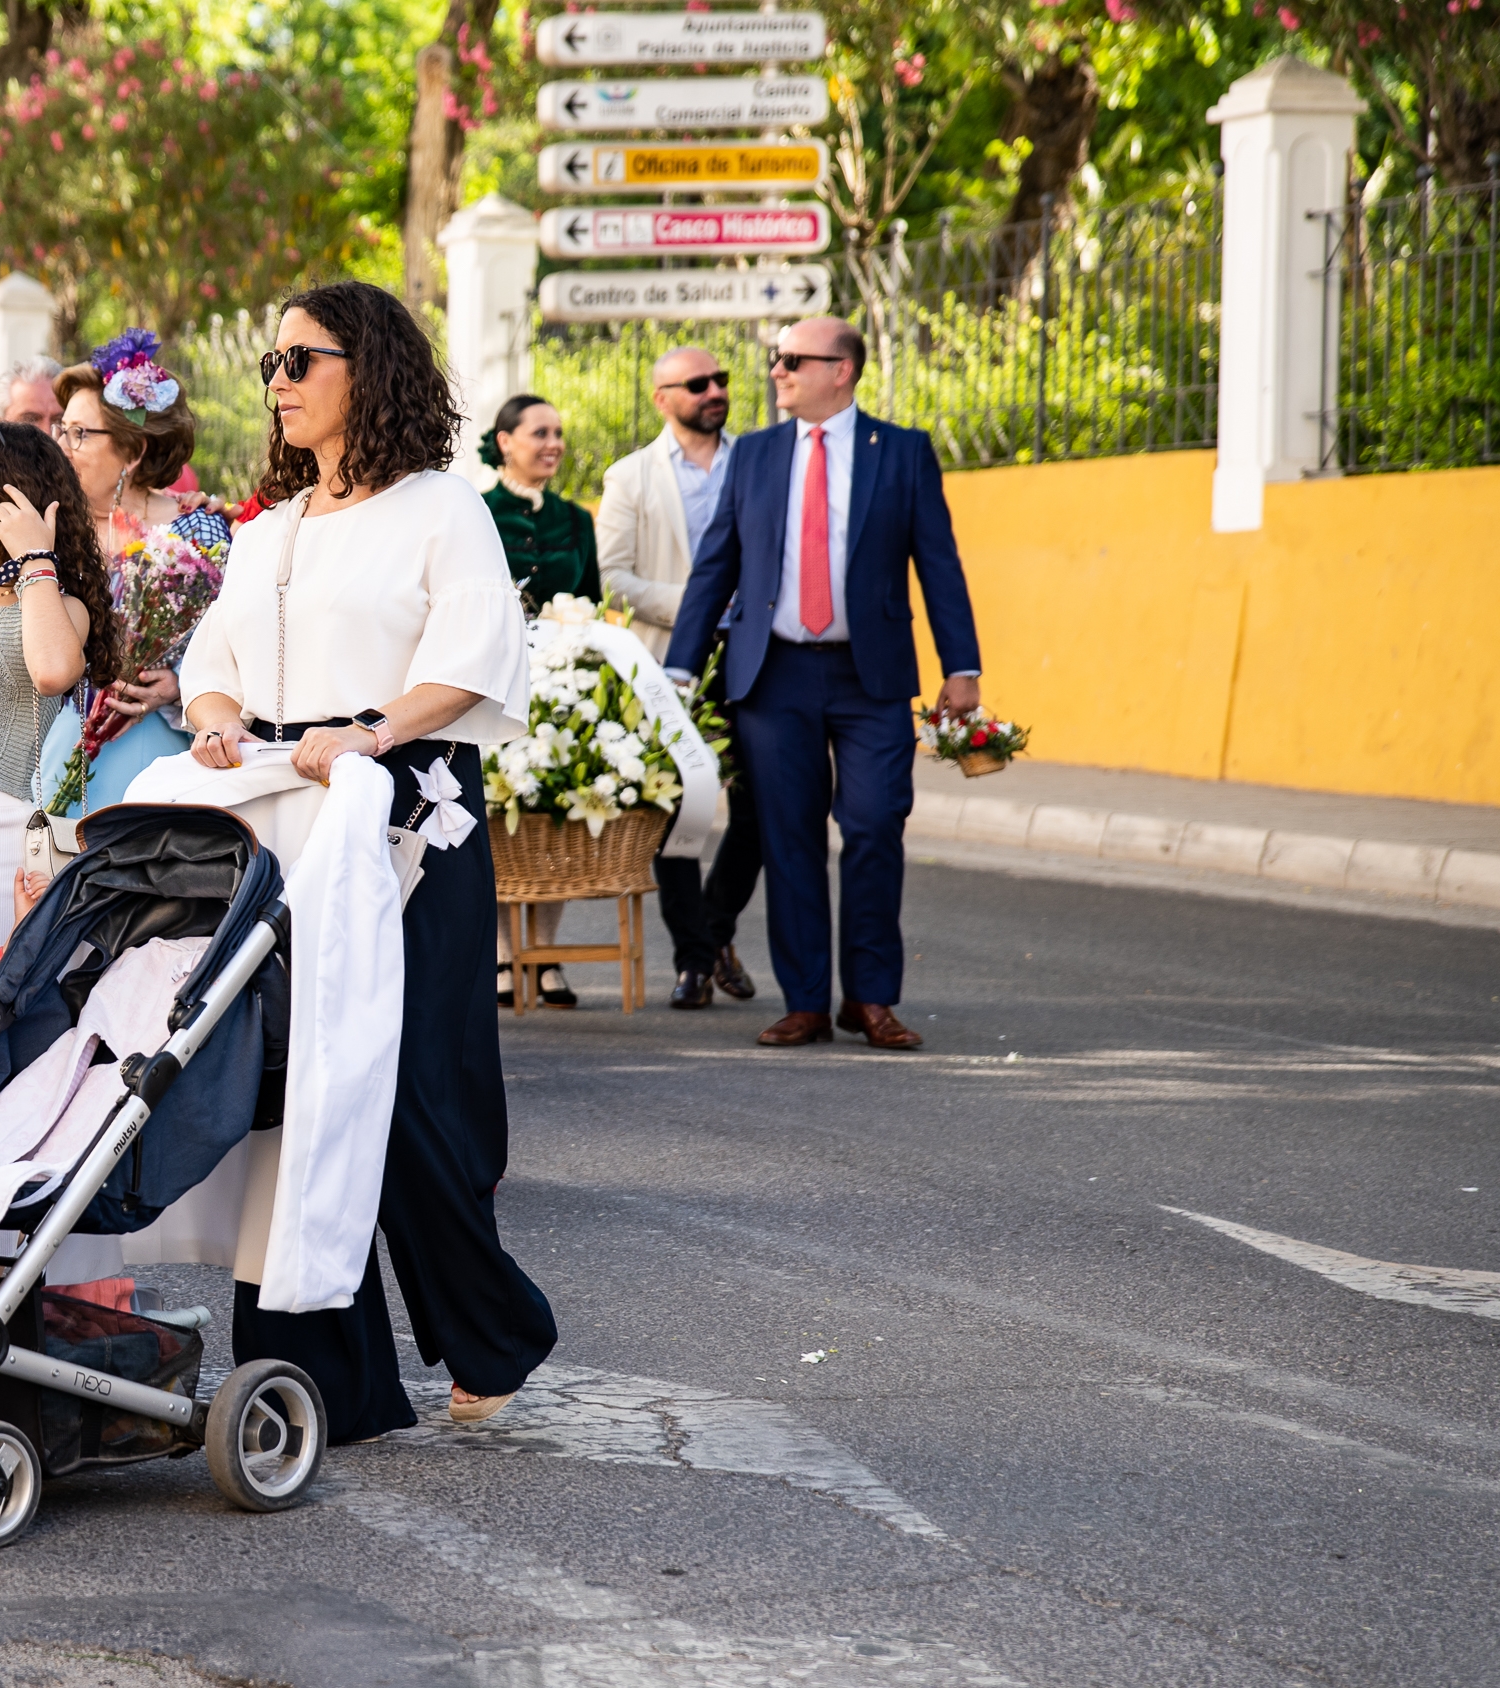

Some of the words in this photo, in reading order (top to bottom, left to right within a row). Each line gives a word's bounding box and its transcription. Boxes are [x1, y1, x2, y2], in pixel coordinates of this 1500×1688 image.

[683, 16, 810, 33] Ayuntamiento
[638, 40, 705, 56] Palacio
[713, 40, 735, 54] de
[742, 39, 810, 53] Justicia
[753, 80, 810, 97] Centro
[655, 104, 742, 121] Comercial
[749, 103, 810, 118] Abierto
[632, 153, 699, 175] Oficina
[706, 153, 729, 173] de
[738, 153, 813, 173] Turismo
[656, 214, 720, 240] Casco
[722, 212, 814, 239] Histórico
[569, 284, 636, 306] Centro
[644, 282, 668, 303] de
[676, 281, 733, 301] Salud
[113, 1121, 137, 1156] mutsy
